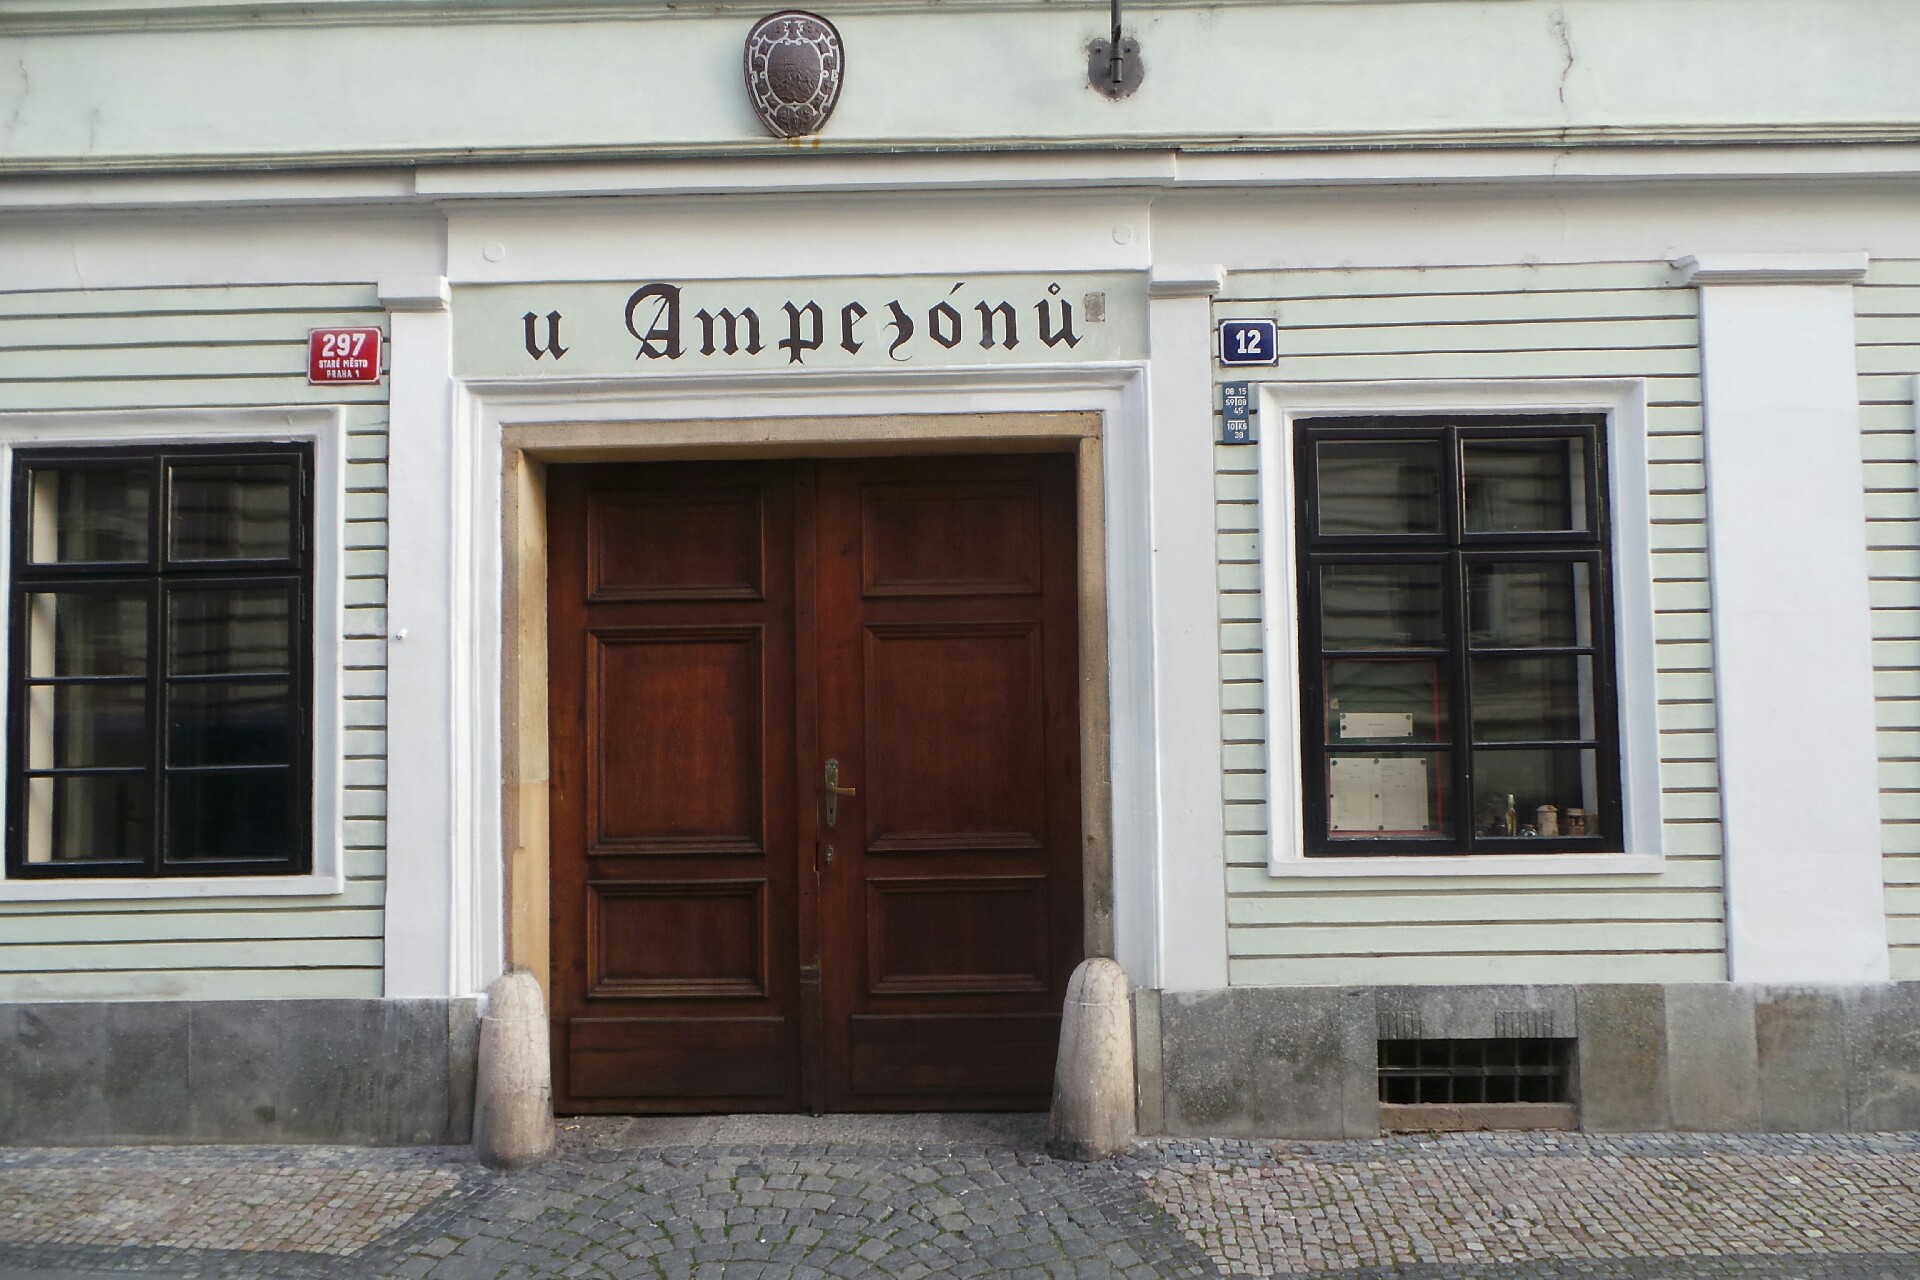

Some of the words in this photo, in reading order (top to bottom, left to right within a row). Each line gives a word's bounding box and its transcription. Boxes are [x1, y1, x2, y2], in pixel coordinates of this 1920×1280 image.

[521, 309, 569, 360] u
[625, 282, 1084, 365] Ampezónů
[322, 333, 366, 357] 297
[1236, 329, 1261, 354] 12
[318, 358, 340, 368] STARÉ
[343, 357, 368, 368] MĚSTO
[326, 369, 352, 378] PRAHA
[355, 369, 360, 378] 1
